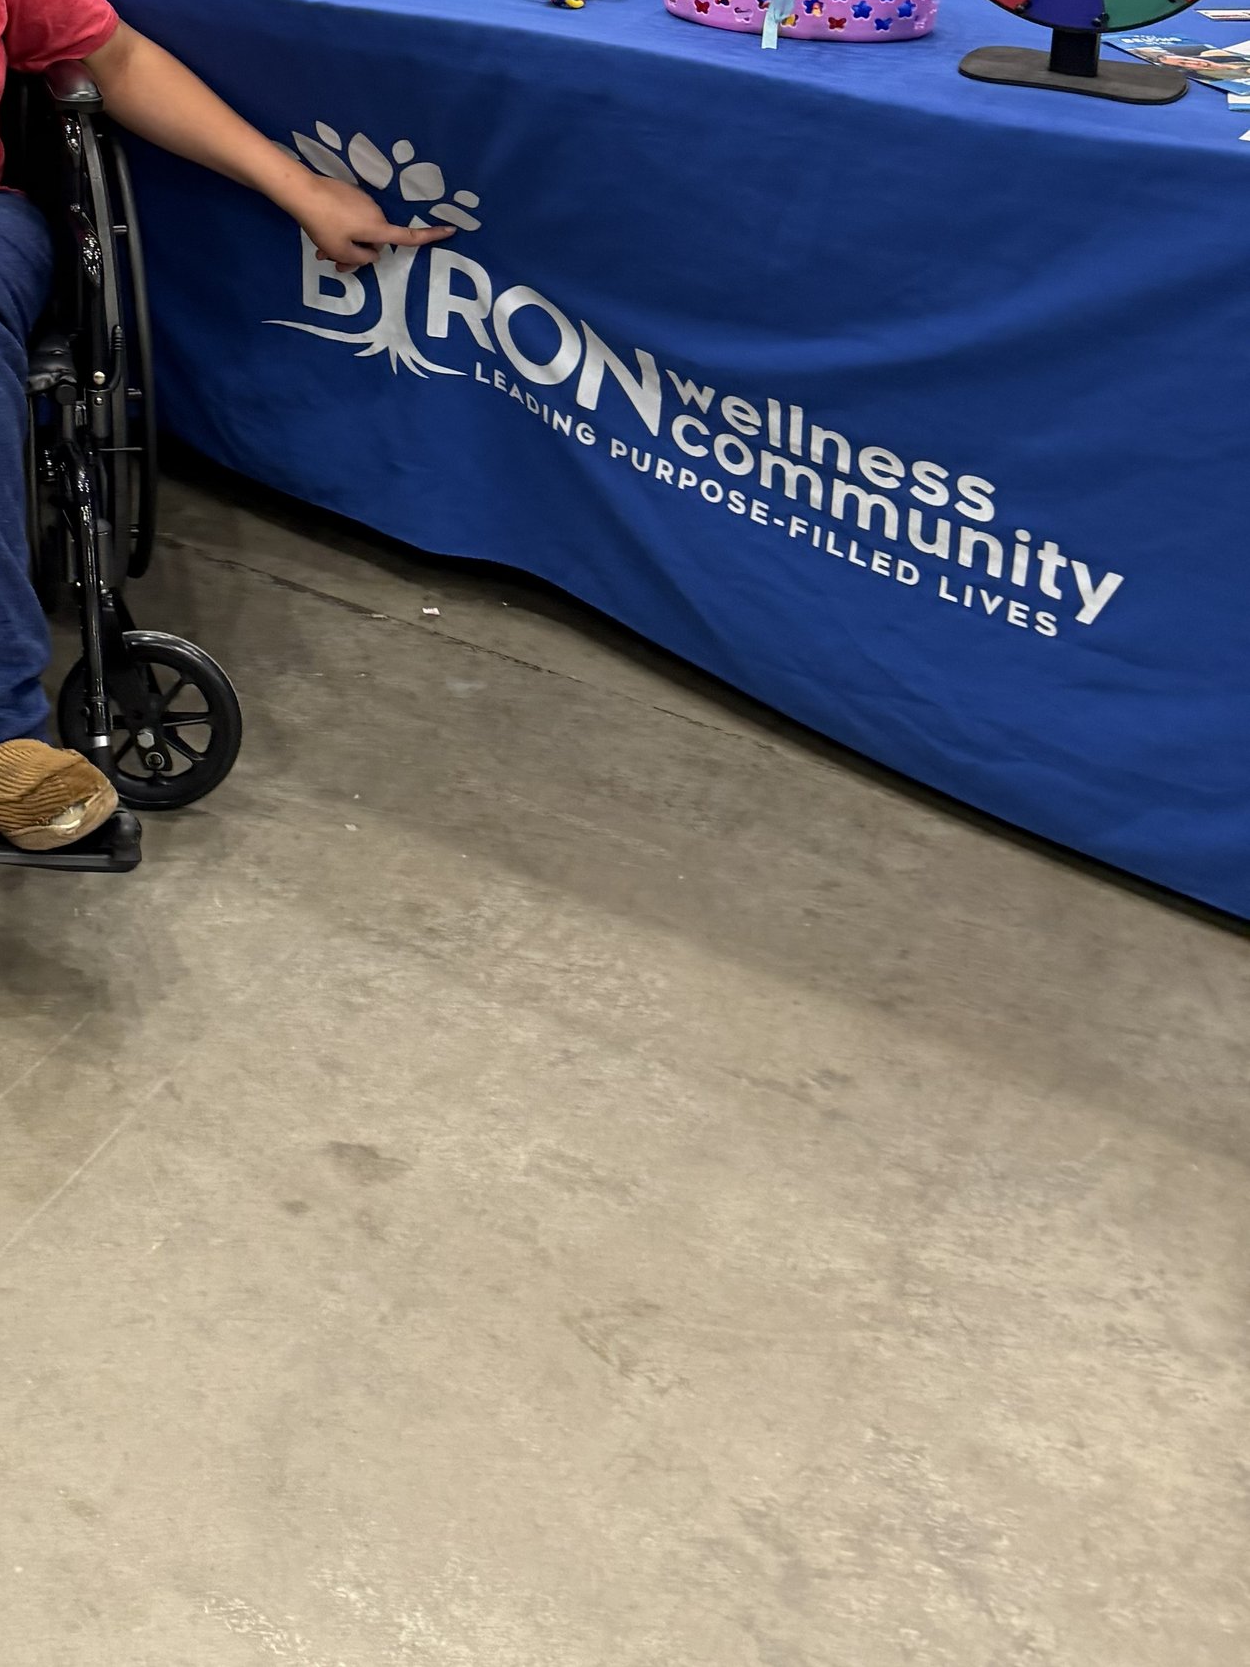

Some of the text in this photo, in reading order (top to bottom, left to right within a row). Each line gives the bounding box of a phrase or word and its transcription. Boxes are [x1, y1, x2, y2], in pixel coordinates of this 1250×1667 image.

[301, 215, 997, 523] BYRON wellness
[474, 361, 1059, 638] LEADING PURPOSE-FILLED LIVES
[670, 414, 1125, 627] community
